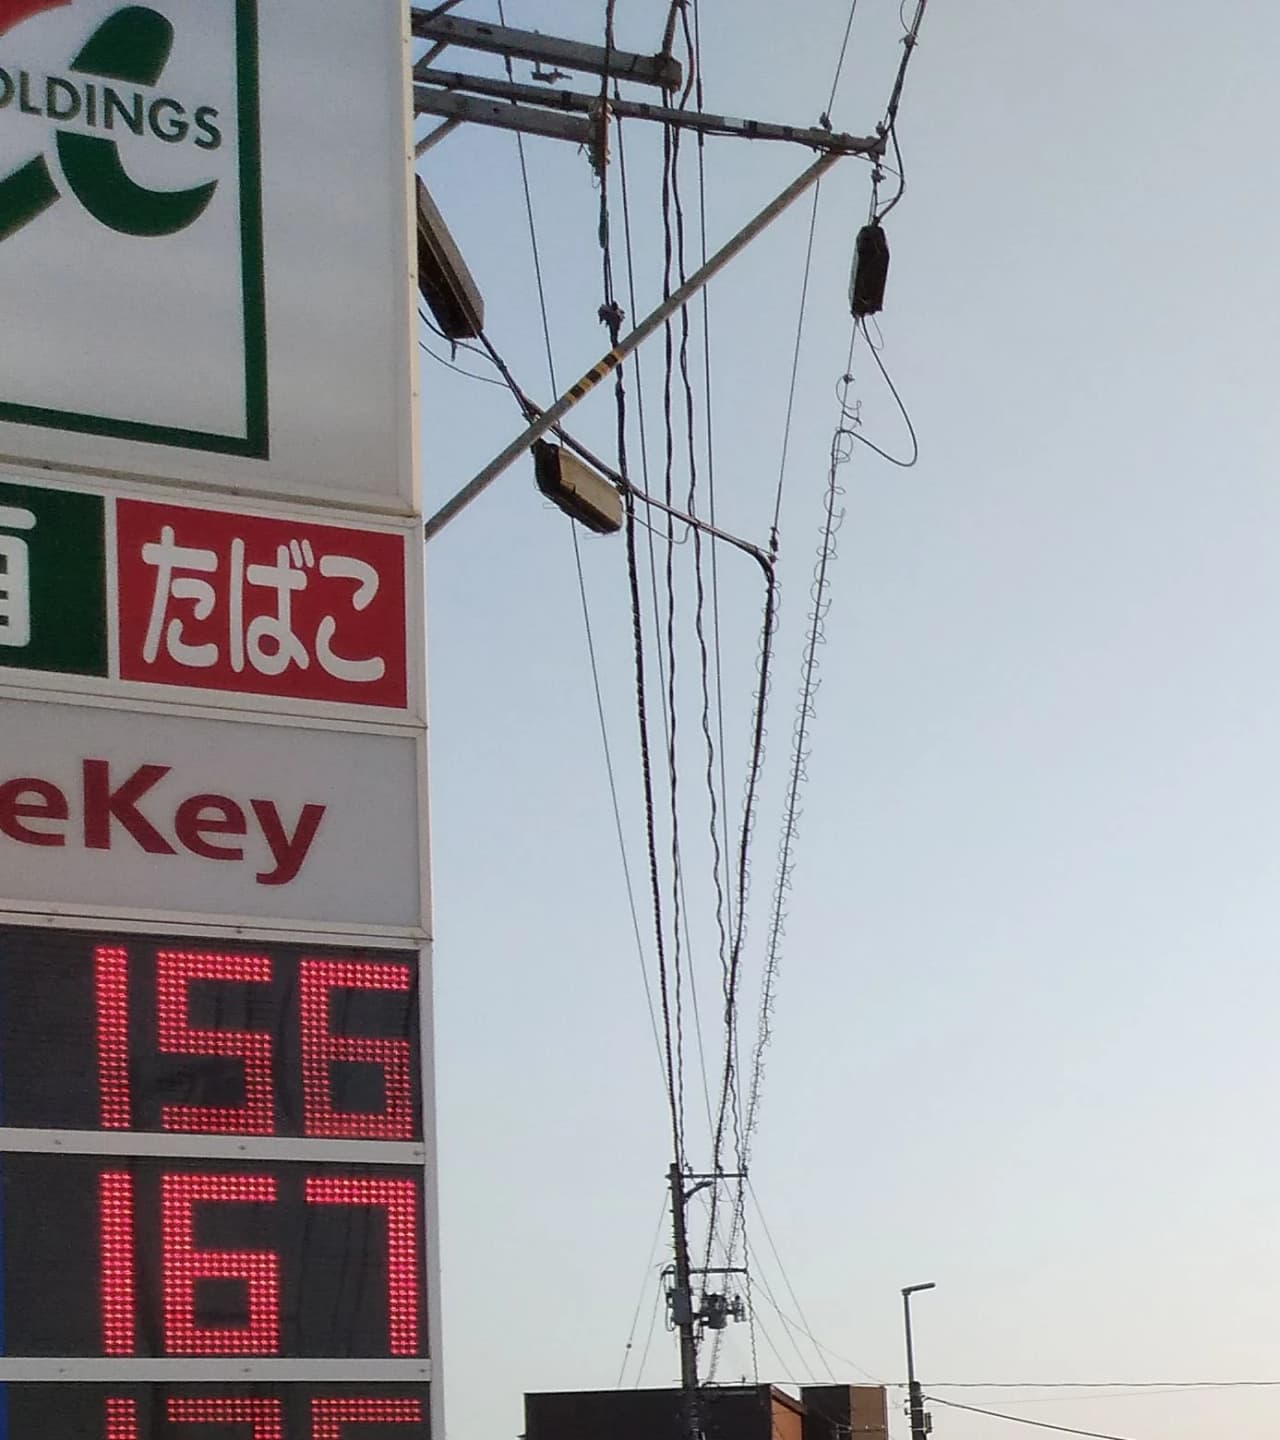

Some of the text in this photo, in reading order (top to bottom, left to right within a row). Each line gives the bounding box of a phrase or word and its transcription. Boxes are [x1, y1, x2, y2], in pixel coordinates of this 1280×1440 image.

[141, 525, 386, 682] たばこ
[0, 758, 327, 886] eKey
[94, 945, 413, 1139] 156
[100, 1171, 418, 1356] 167
